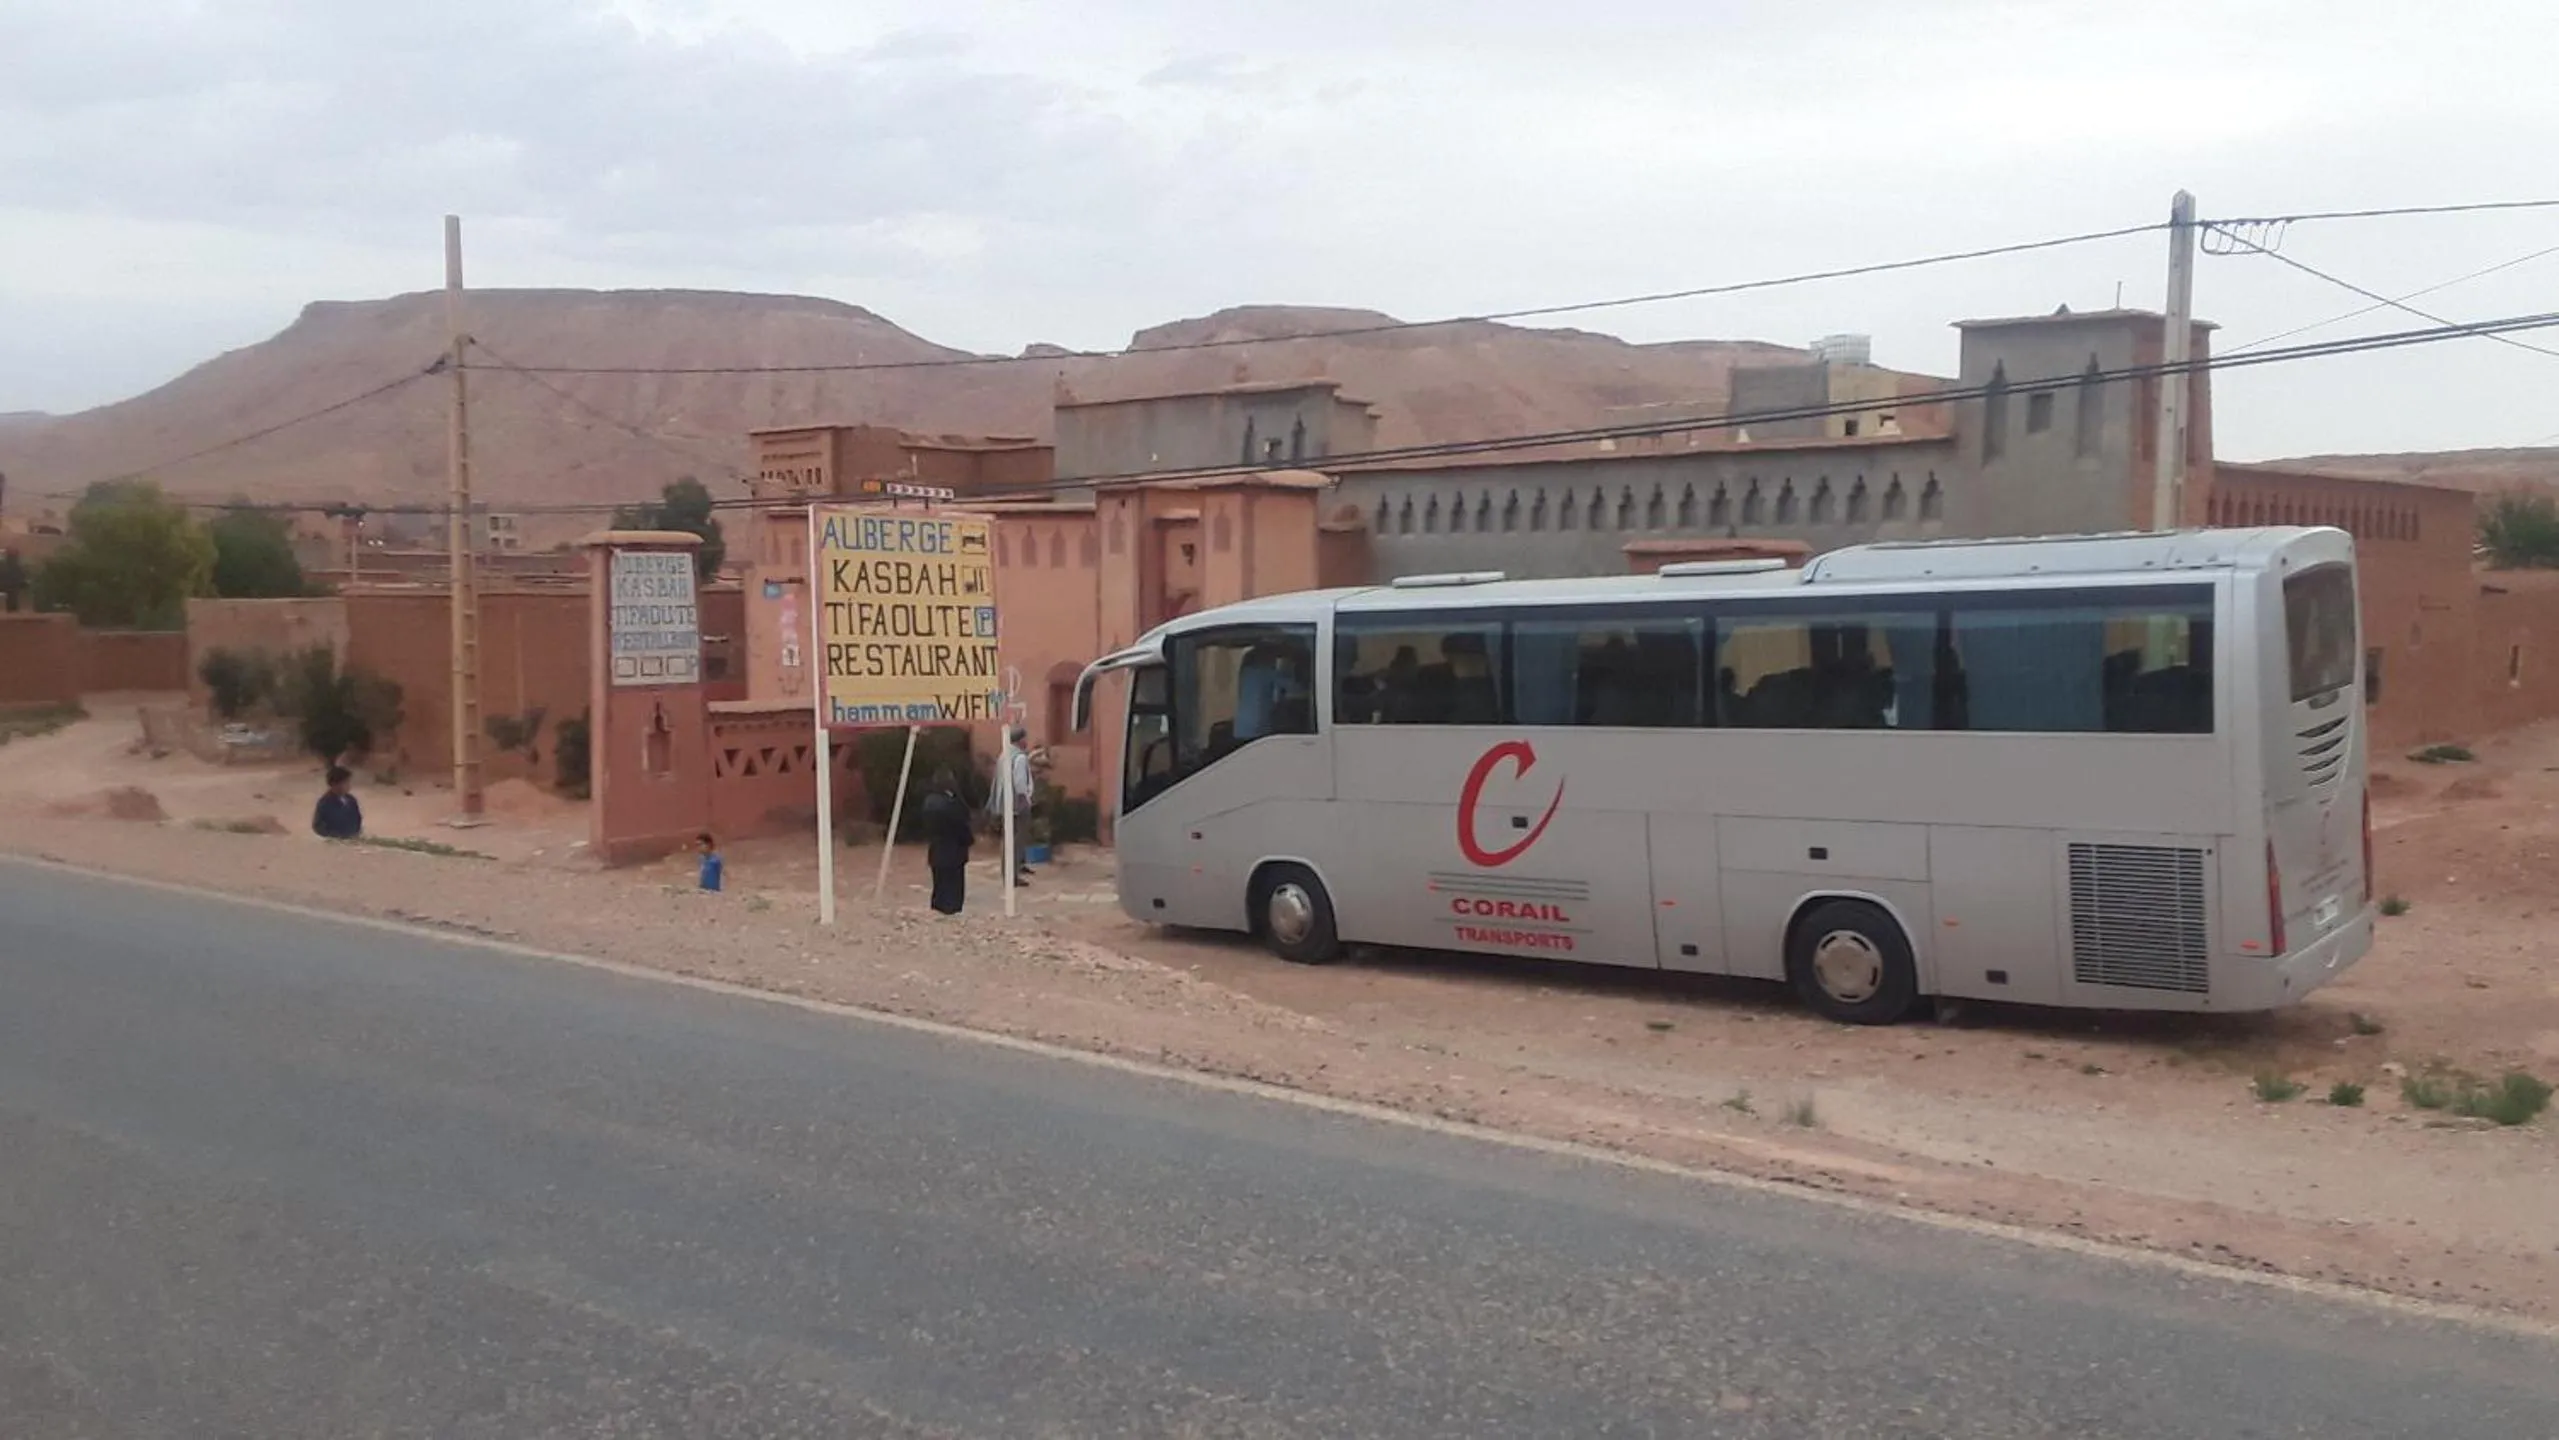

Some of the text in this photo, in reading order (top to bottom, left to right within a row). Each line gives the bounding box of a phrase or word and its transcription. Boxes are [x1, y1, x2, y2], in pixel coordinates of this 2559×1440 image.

[821, 516, 954, 554] AUBERGE
[616, 577, 688, 599] KASBAH
[833, 559, 957, 596] KASBAH
[827, 644, 998, 677] RESTAURANT
[1452, 898, 1570, 922] CORAIL
[1455, 926, 1574, 950] TRANSPORTS
